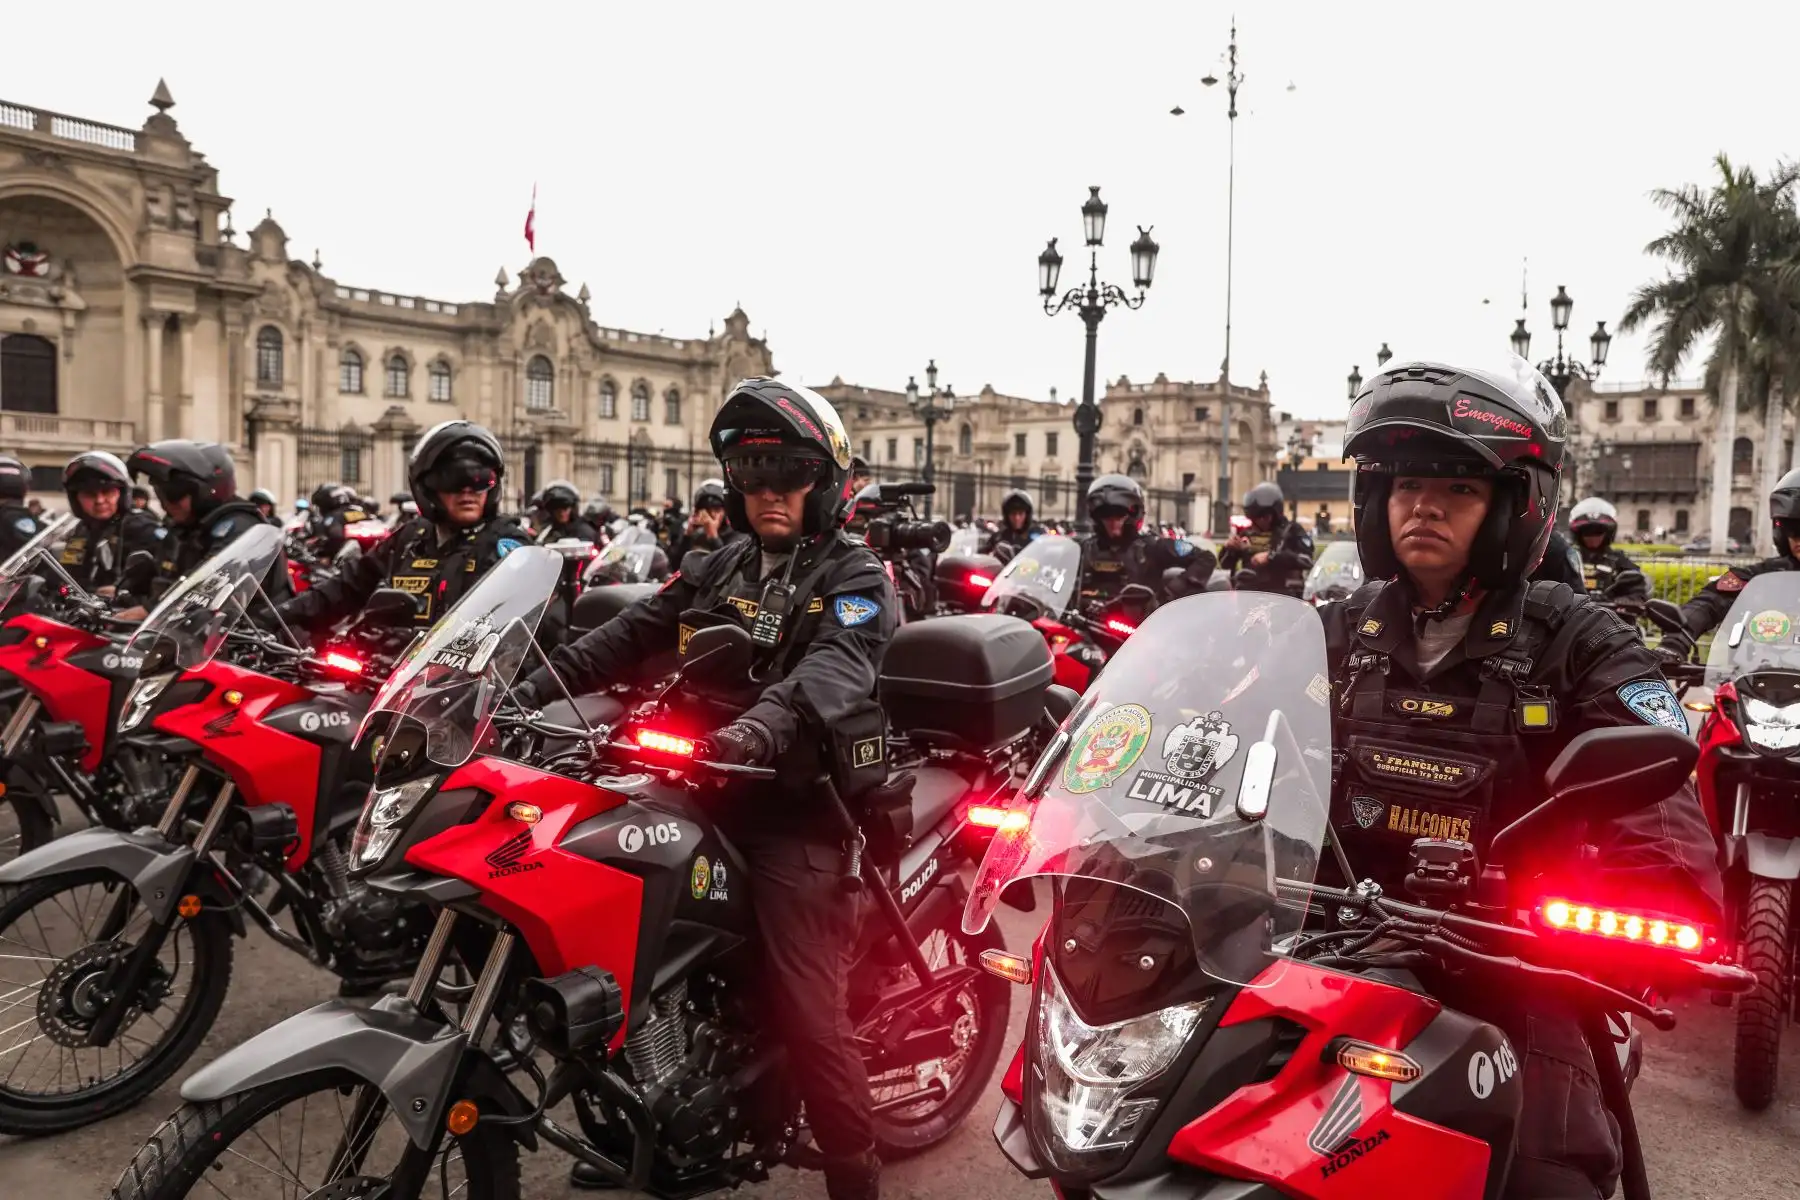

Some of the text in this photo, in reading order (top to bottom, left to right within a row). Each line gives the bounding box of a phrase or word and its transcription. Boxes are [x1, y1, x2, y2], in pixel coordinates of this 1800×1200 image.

[1453, 399, 1532, 438] Emergencia
[120, 656, 143, 668] 105
[429, 651, 467, 671] LIMA
[320, 711, 351, 728] 105
[1387, 756, 1440, 773] FRANCIA
[1140, 770, 1222, 796] MUNICIPALIDAD DE
[1128, 778, 1212, 818] LIMA
[645, 822, 681, 846] 105
[1387, 804, 1471, 842] HALCONES
[488, 861, 545, 879] HONDA
[709, 890, 728, 901] LIMA
[1493, 1039, 1518, 1084] 105
[1320, 1129, 1392, 1180] HONDA
